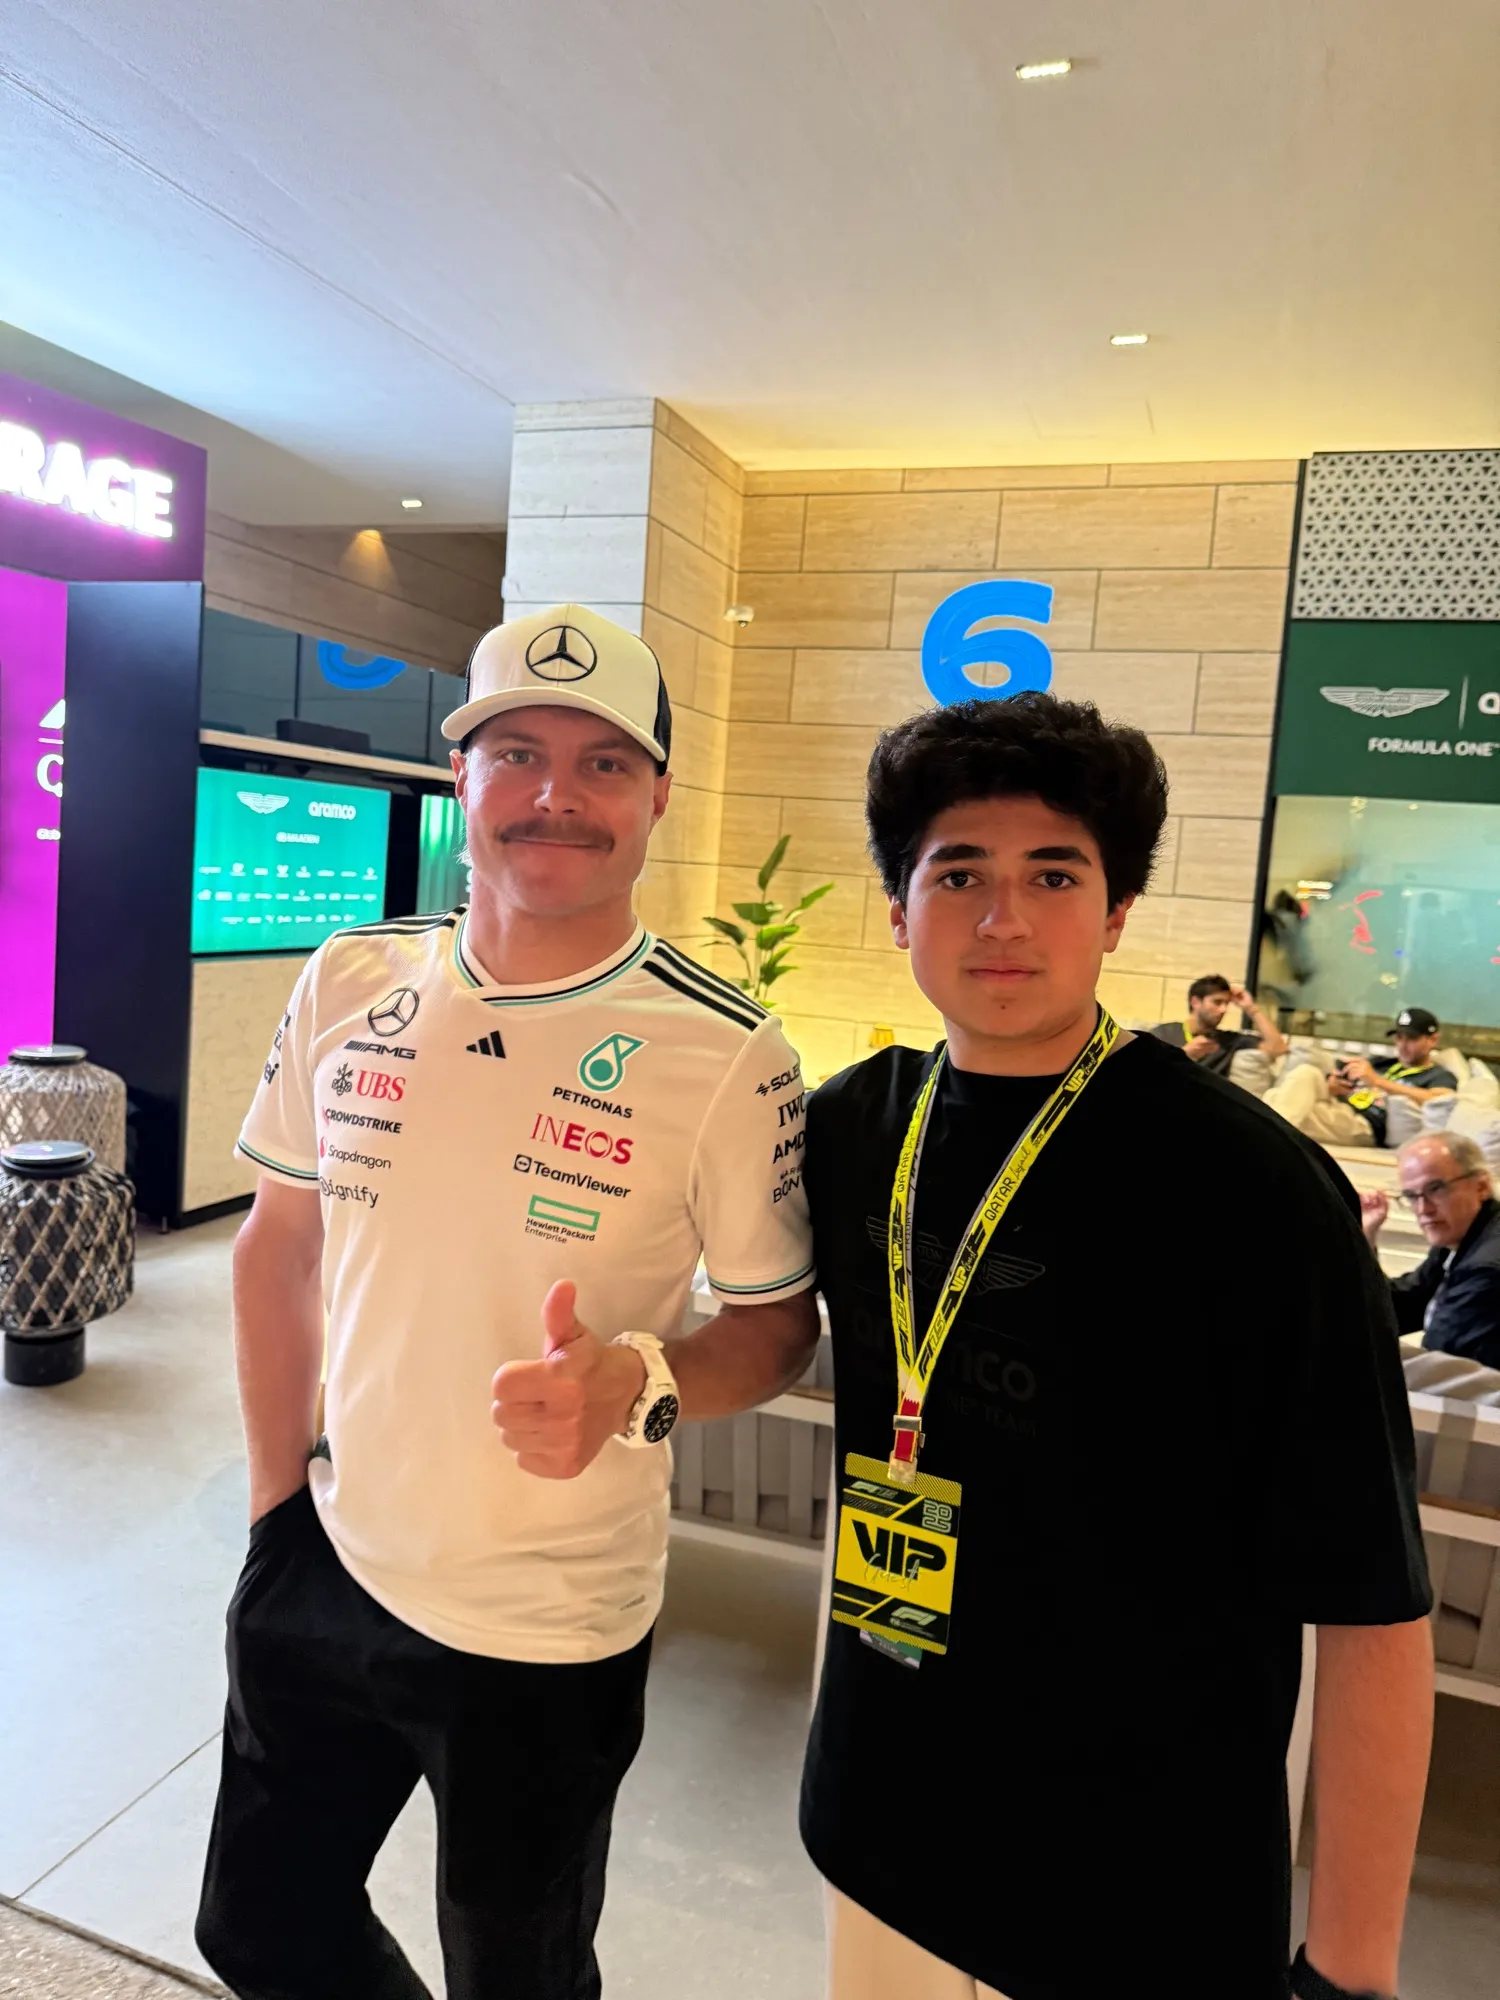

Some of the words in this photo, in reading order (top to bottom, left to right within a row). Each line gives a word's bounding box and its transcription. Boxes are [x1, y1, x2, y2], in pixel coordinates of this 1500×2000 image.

[0, 420, 173, 538] RAGE
[921, 569, 1054, 708] 6
[1367, 737, 1452, 756] FORMULA
[1454, 740, 1494, 757] ONE
[308, 801, 356, 821] aramco
[364, 1042, 418, 1061] AMG
[356, 1069, 407, 1102] UBS
[1064, 1068, 1084, 1092] VIP
[552, 1086, 633, 1119] PETRONAS
[324, 1107, 403, 1134] CROWDSTRIKE
[530, 1112, 635, 1165] INEOS
[772, 1130, 806, 1165] AMD
[327, 1144, 392, 1170] Snapdragon
[897, 1151, 911, 1193] QATAR
[533, 1160, 632, 1199] TeamViewer
[984, 1176, 1016, 1222] QATAR
[524, 1225, 568, 1245] Enterprise
[526, 1217, 561, 1234] Hewlett
[560, 1226, 597, 1242] Packard
[893, 1243, 903, 1272] VIP
[949, 1265, 967, 1292] VIP
[851, 1518, 947, 1582] VIP
